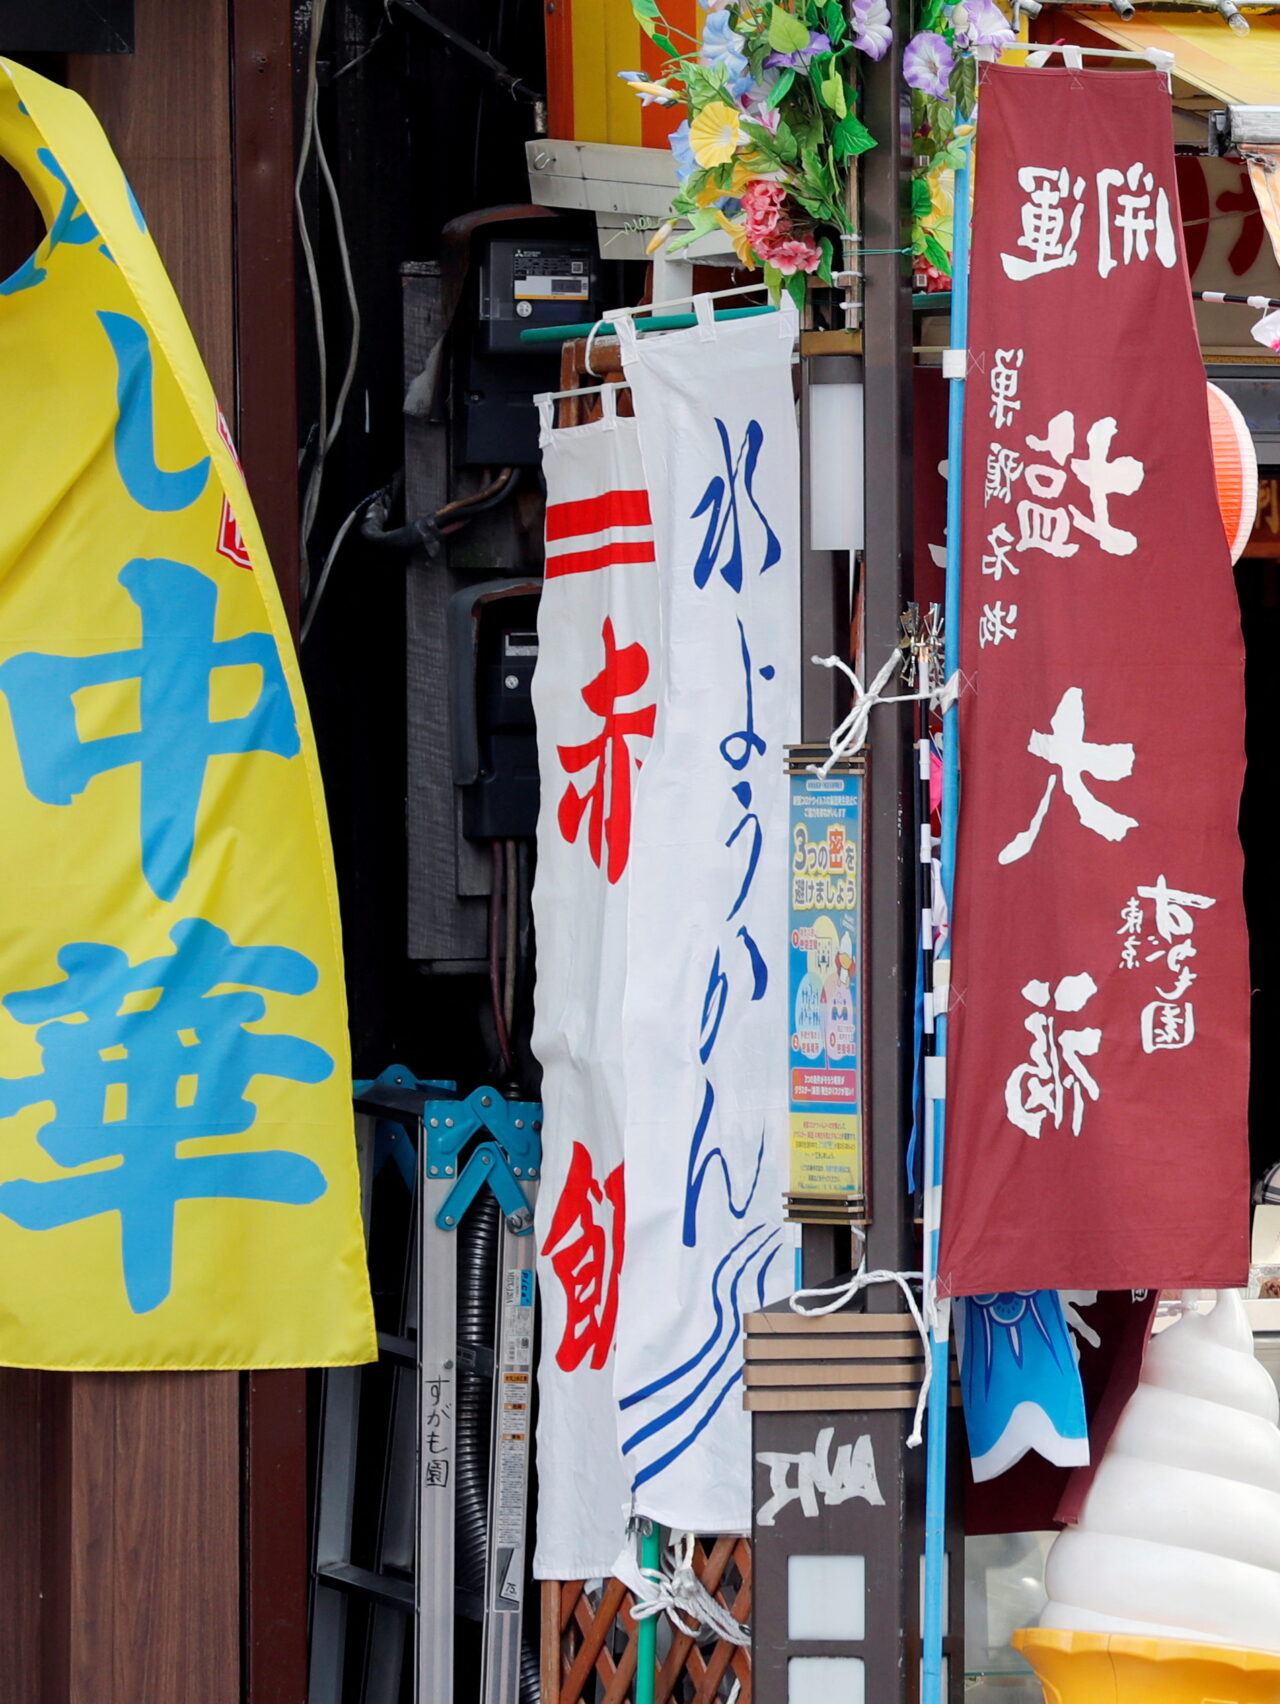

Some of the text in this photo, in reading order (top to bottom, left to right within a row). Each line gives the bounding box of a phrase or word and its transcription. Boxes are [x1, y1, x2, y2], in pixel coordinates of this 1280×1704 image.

[683, 416, 782, 1248] 水ようかん
[424, 1374, 452, 1489] すがも園
